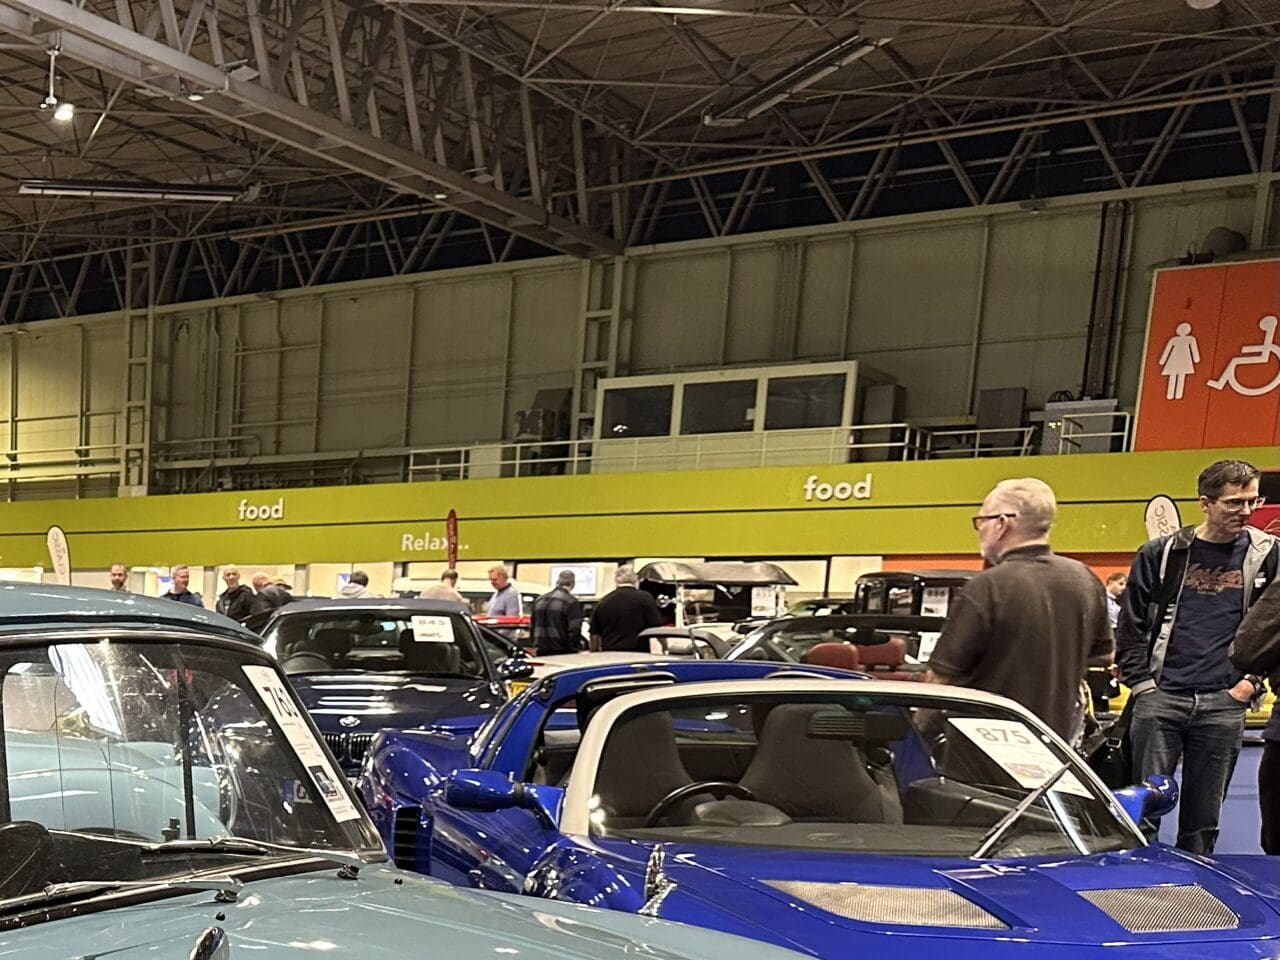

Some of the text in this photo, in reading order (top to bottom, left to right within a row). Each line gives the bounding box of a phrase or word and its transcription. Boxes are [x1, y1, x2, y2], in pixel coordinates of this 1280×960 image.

[803, 473, 873, 501] food
[238, 497, 284, 521] food
[401, 532, 470, 551] Relax..
[975, 727, 1032, 745] 875
